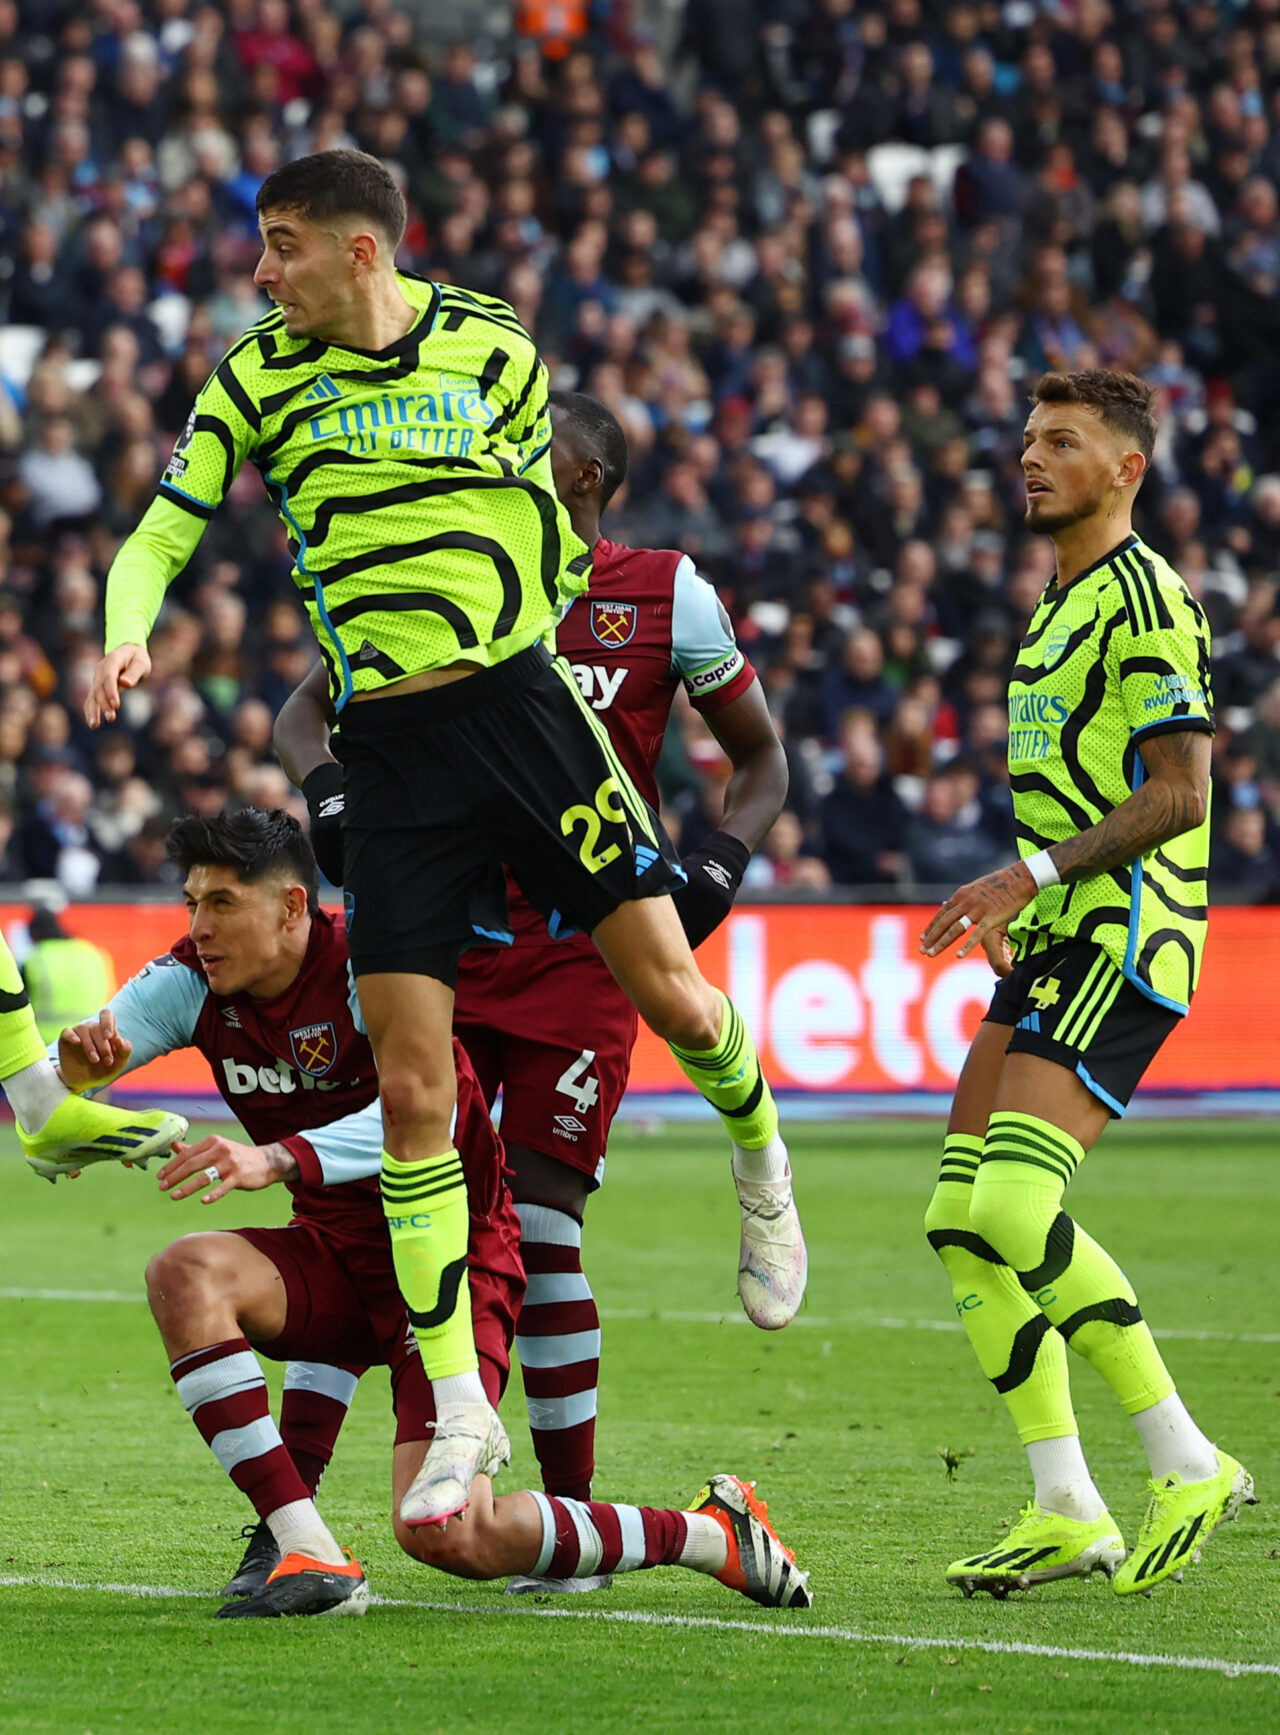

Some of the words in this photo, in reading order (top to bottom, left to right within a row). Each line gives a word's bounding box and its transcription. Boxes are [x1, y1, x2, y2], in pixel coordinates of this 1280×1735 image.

[310, 391, 495, 440] Emirates
[390, 427, 474, 458] BETTER
[1153, 674, 1188, 691] VISIT
[1143, 689, 1206, 711] RWANDA
[561, 777, 633, 874] 29
[555, 1049, 599, 1114] 4
[552, 1127, 578, 1142] umbro
[955, 1293, 984, 1317] FC
